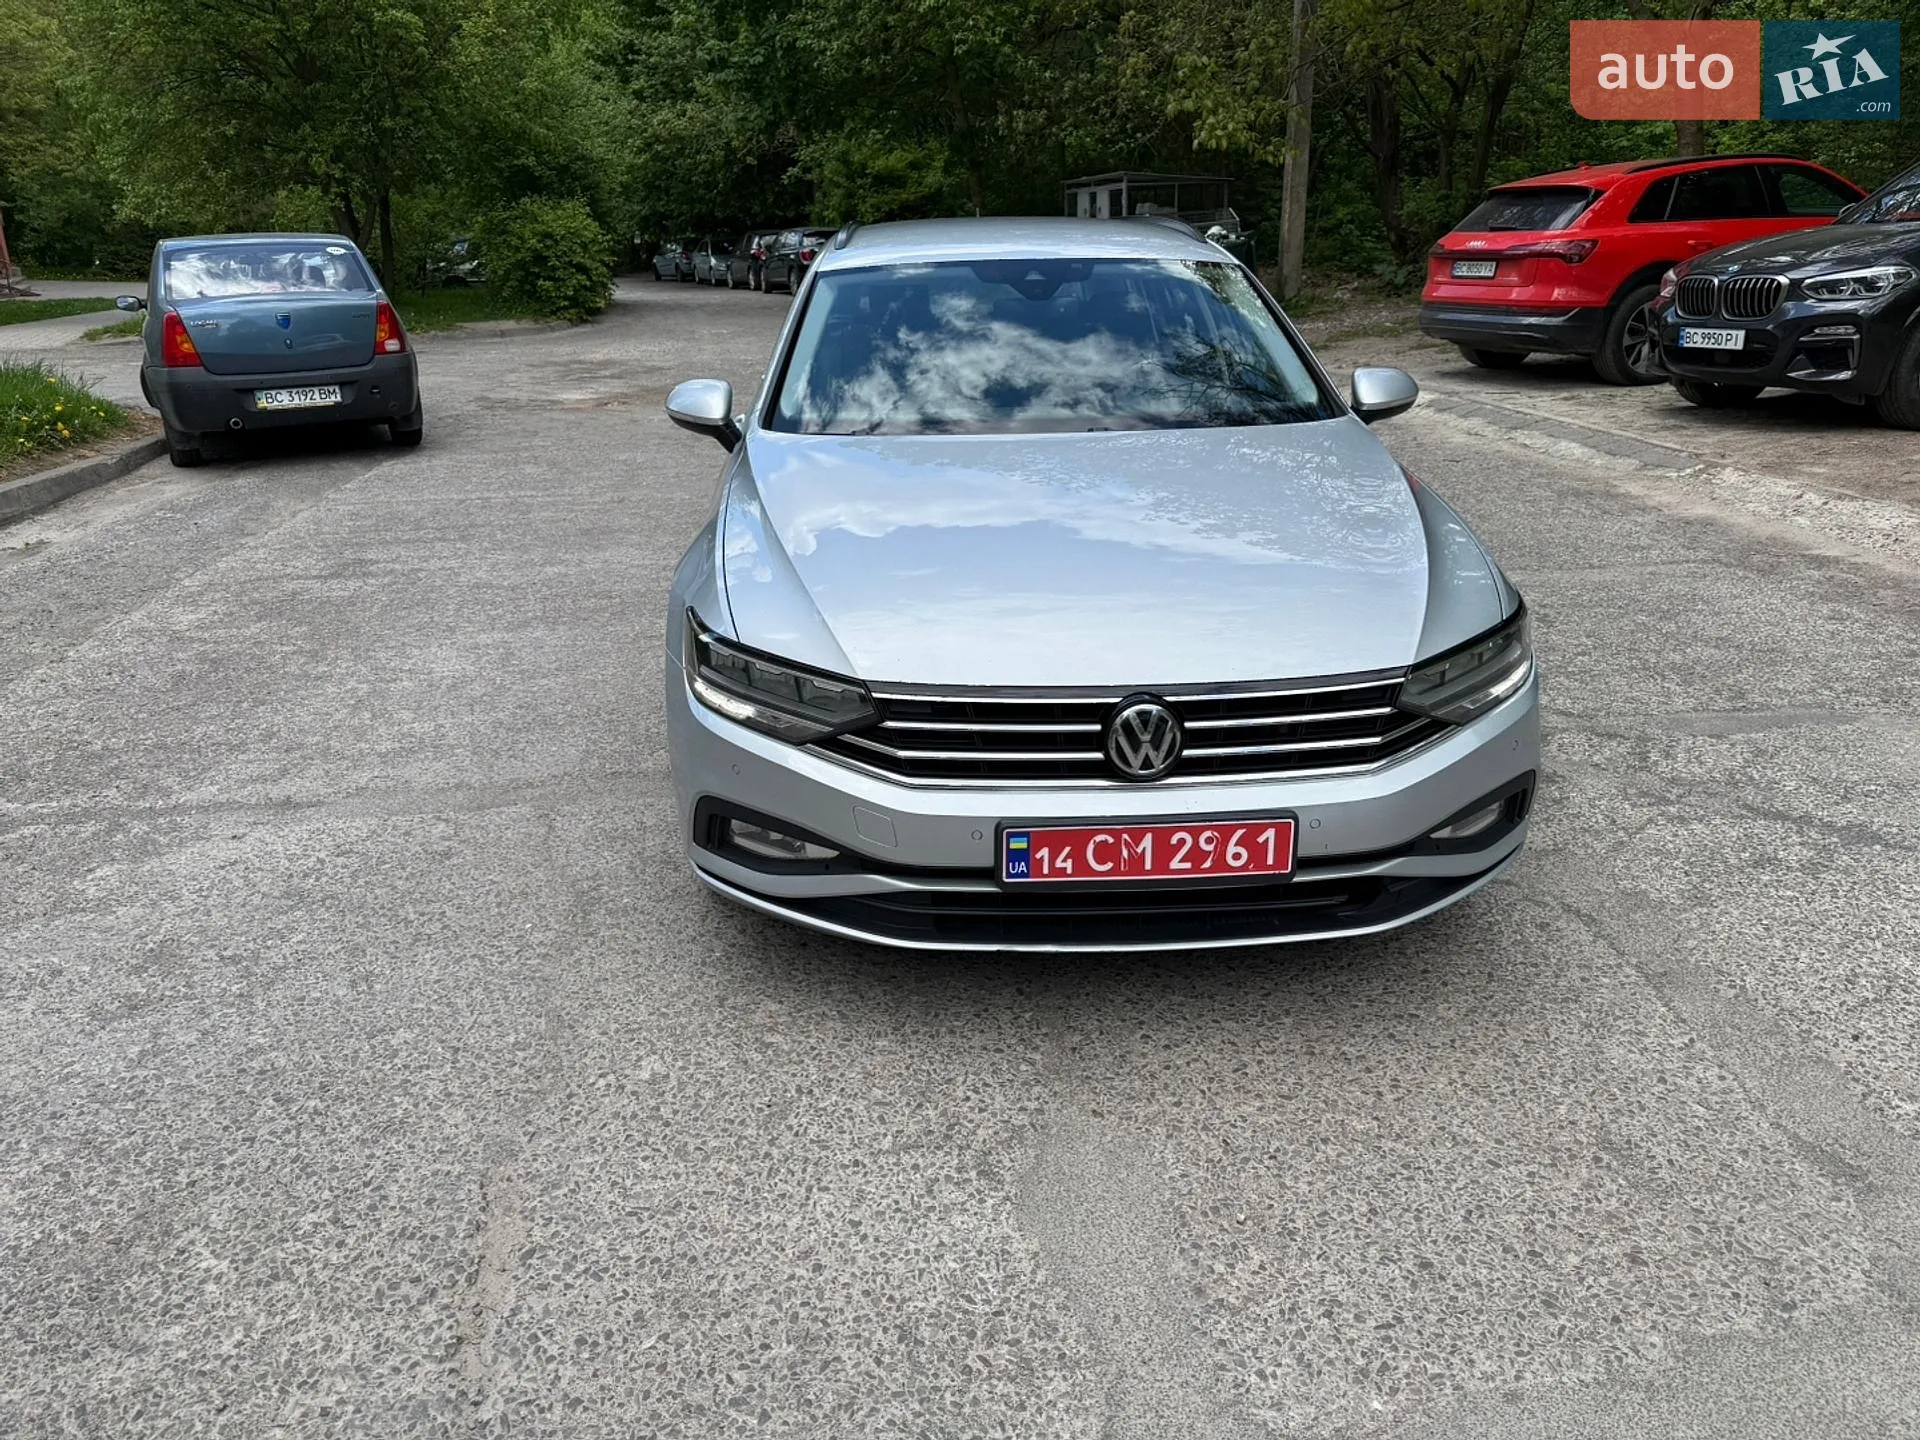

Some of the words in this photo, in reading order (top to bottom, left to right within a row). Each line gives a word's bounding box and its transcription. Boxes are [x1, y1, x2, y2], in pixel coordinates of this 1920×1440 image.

[1685, 332, 1699, 344] BC
[1701, 332, 1723, 346] 9950
[264, 391, 284, 404] BC
[287, 389, 316, 402] 3192
[318, 387, 338, 400] BM
[1034, 846, 1073, 875] 14
[1086, 832, 1152, 872] CM
[1169, 828, 1276, 869] 2961
[1009, 861, 1027, 874] UA
